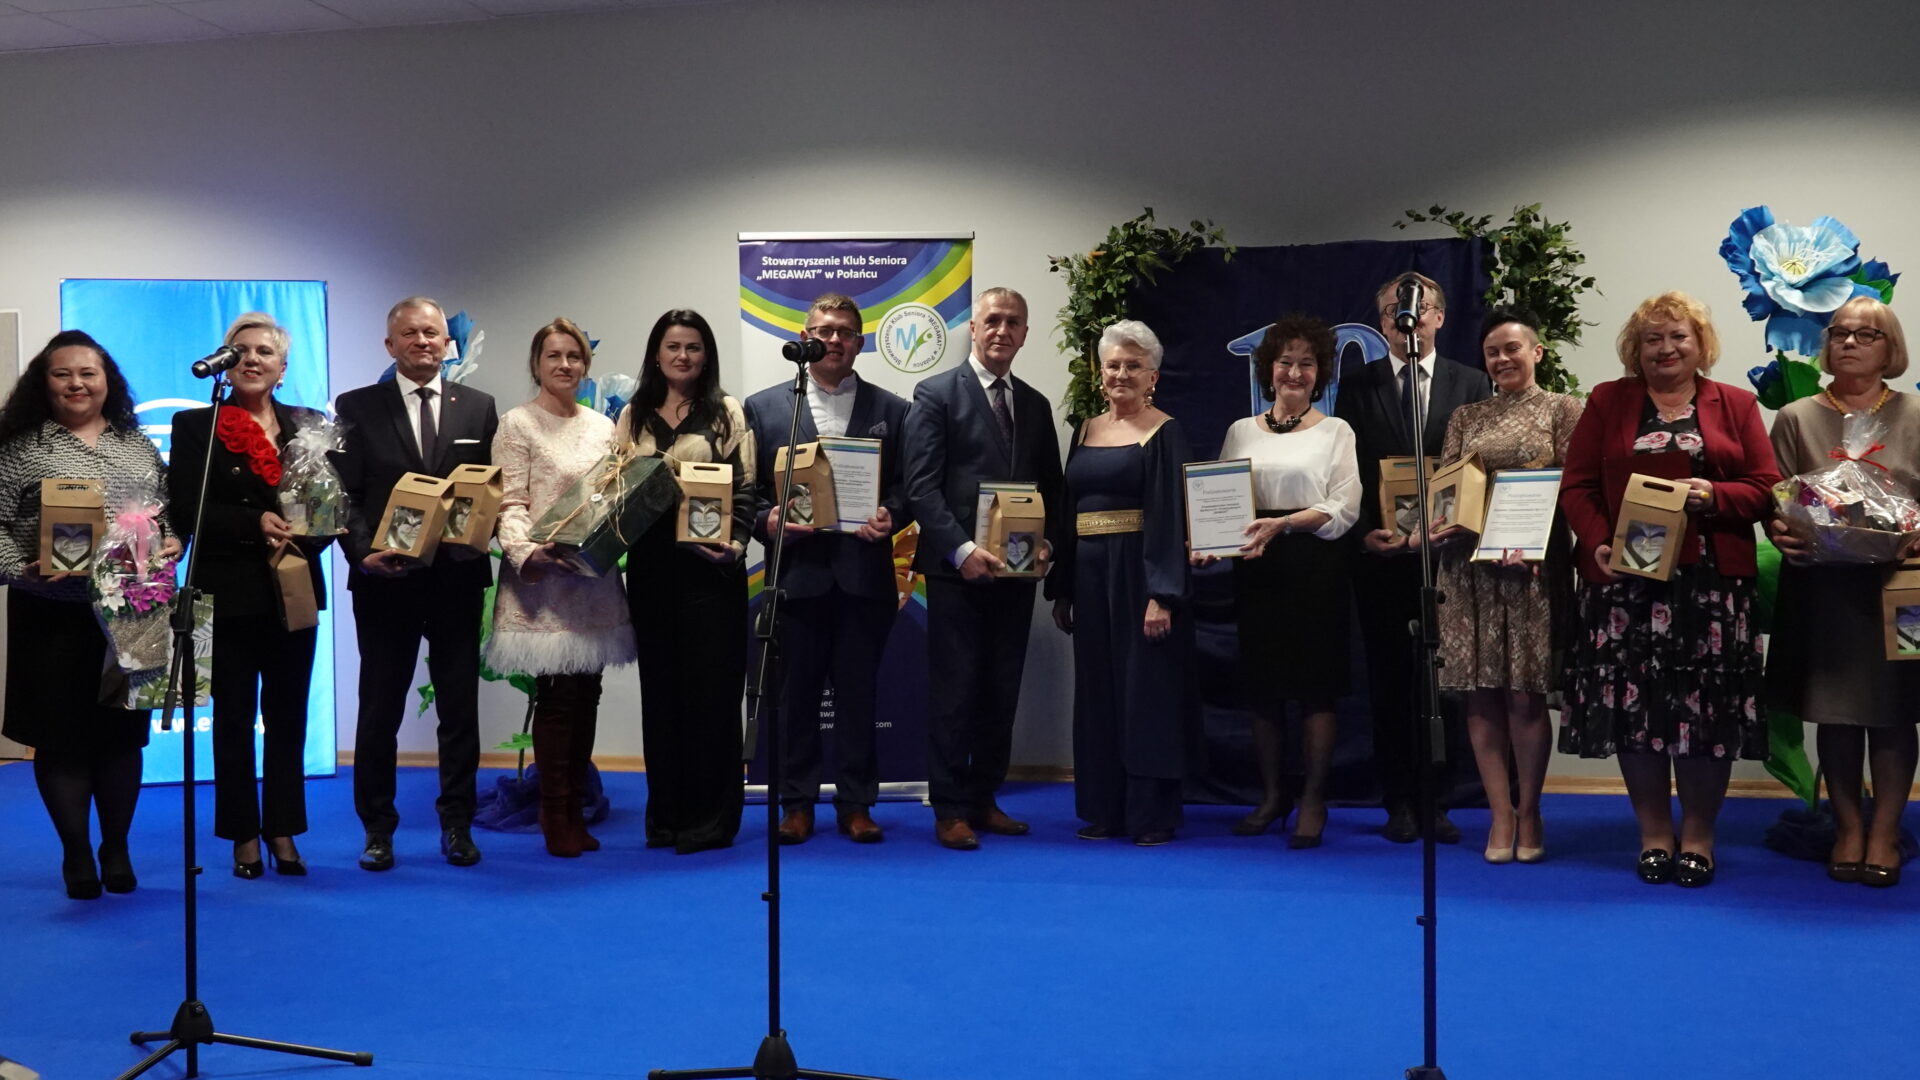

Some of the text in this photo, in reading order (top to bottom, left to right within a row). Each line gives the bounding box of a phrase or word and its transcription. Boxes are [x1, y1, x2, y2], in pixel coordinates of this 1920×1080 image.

[762, 255, 907, 268] Stowarzyszenie Klub Seniora
[824, 271, 835, 279] w
[836, 268, 878, 279] Połańcu
[891, 315, 903, 324] Klub
